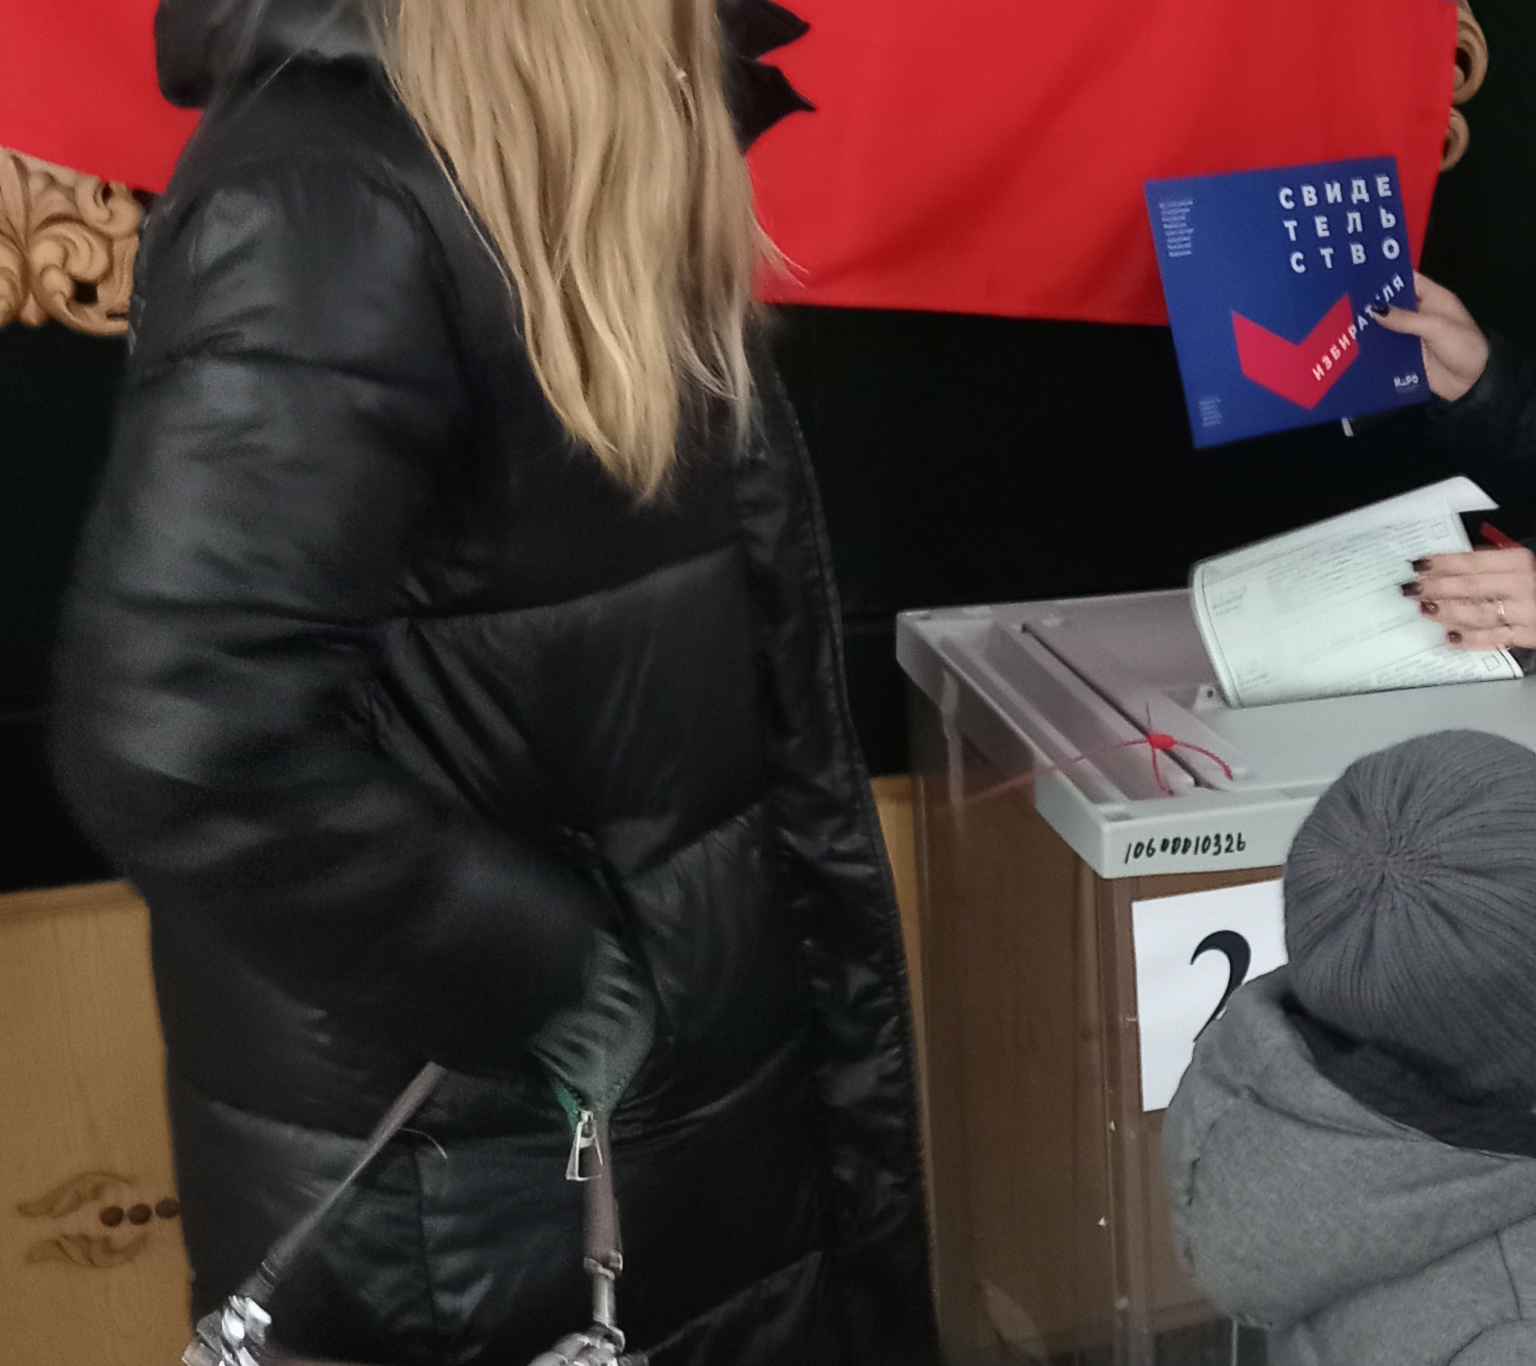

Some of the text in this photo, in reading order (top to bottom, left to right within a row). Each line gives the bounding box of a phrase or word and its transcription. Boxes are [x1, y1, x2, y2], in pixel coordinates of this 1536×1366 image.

[1277, 175, 1393, 210] СВИДЕ
[1282, 205, 1397, 243] ТЕЛЬ
[1289, 237, 1401, 274] СТВО
[1311, 273, 1405, 382] ИЗБИРАТЛЯ
[1124, 832, 1247, 864] 10600010326
